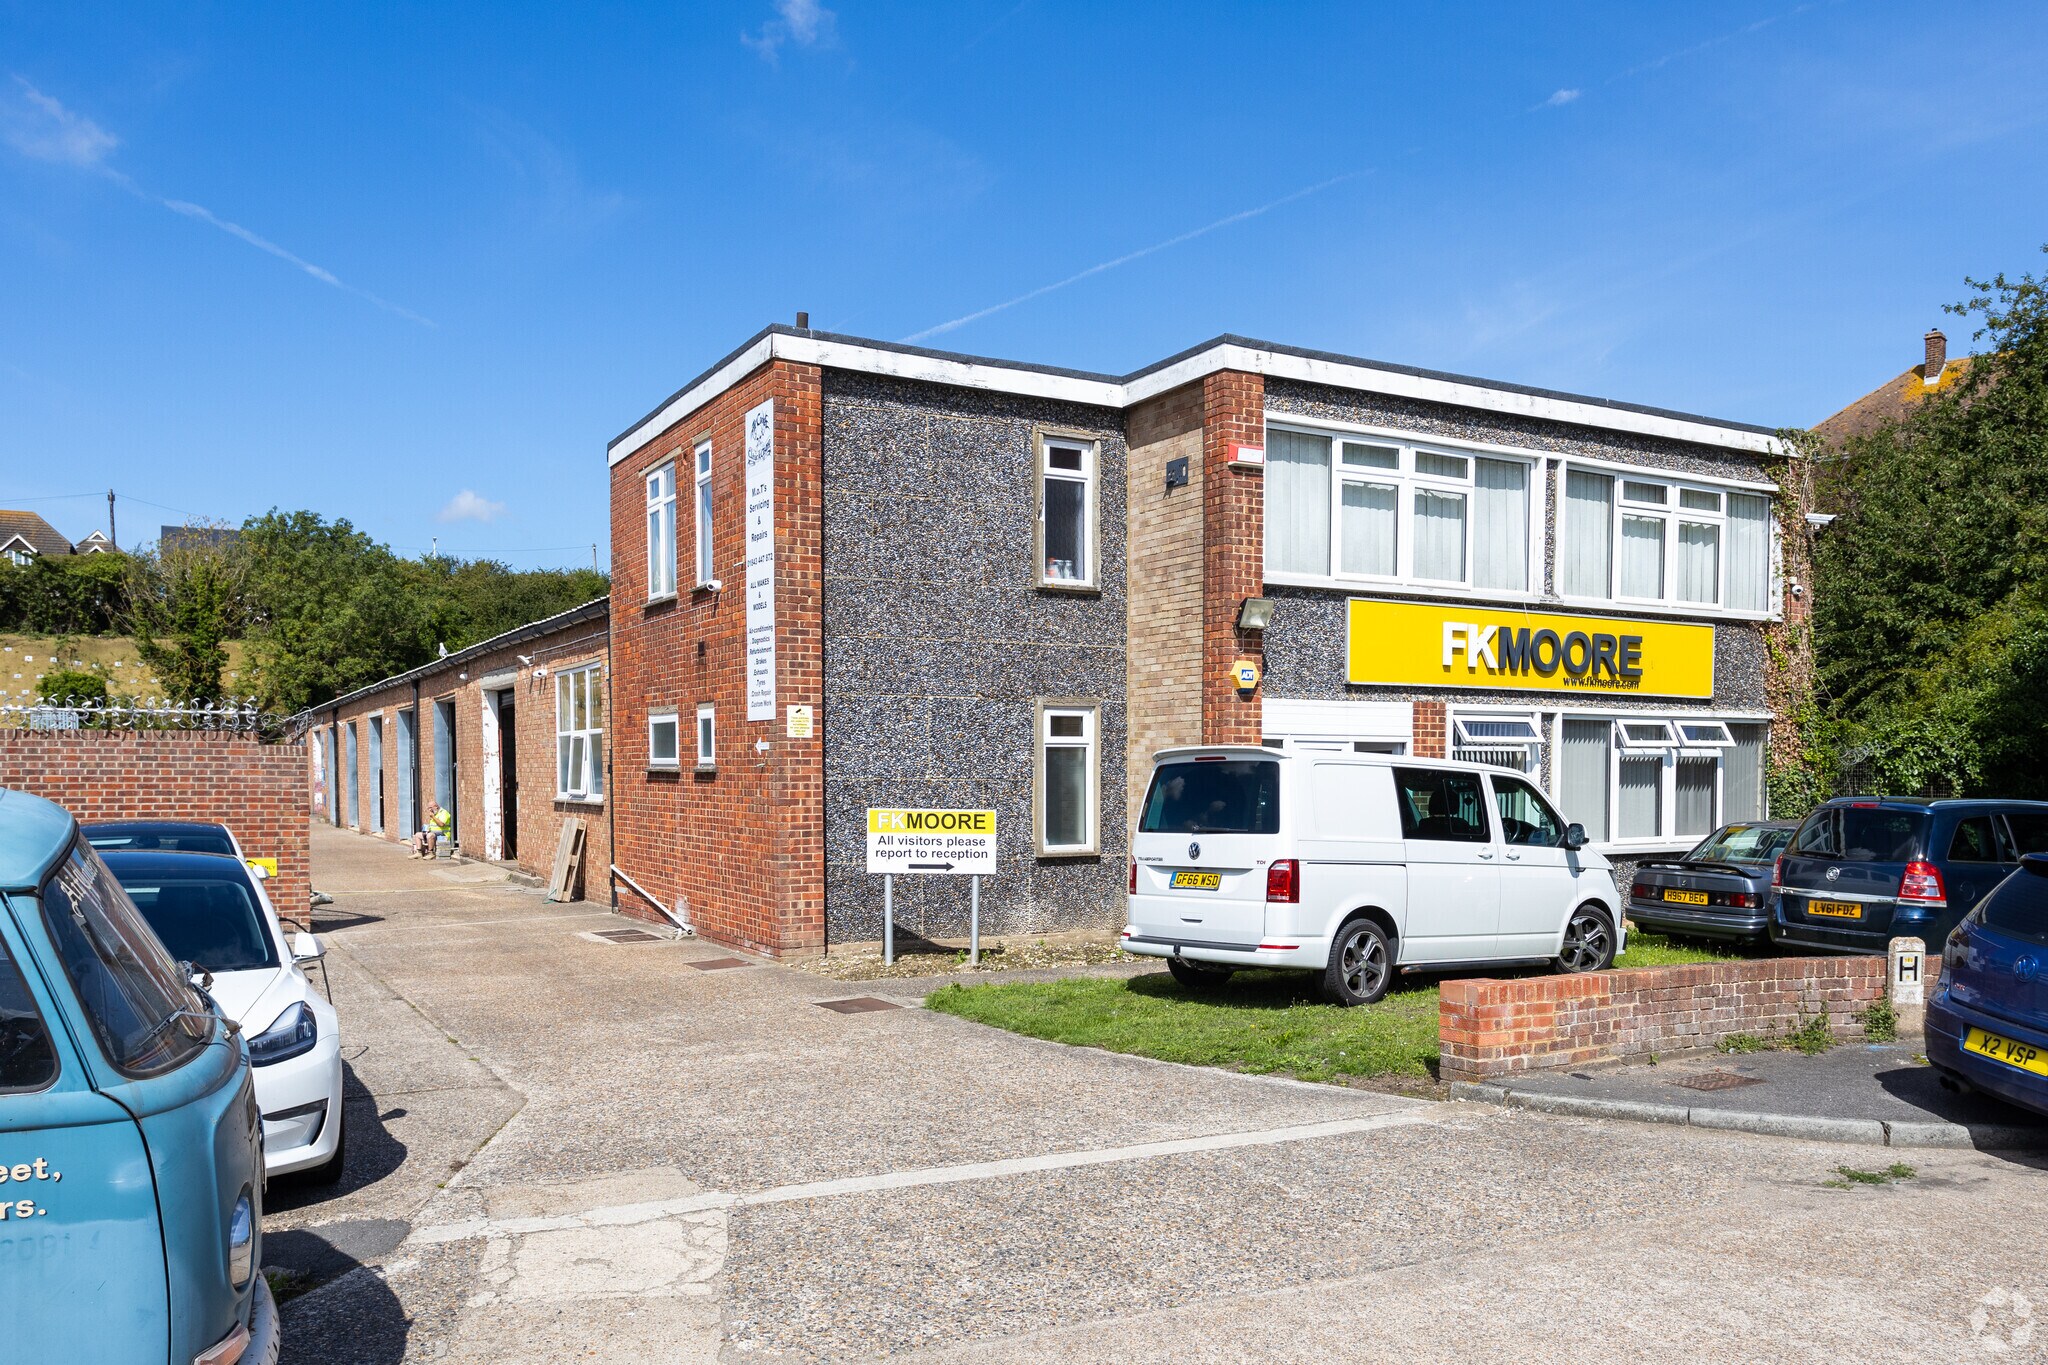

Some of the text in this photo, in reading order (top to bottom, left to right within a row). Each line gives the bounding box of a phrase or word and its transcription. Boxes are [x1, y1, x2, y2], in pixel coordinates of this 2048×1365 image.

[749, 499, 770, 513] Servicing
[751, 530, 767, 543] Repairs
[1442, 621, 1643, 676] FKMOORE
[1241, 670, 1254, 680] ADT
[1563, 676, 1640, 690] www.fkmoore.com
[877, 812, 986, 830] FKMOORE
[877, 835, 986, 848] All visitors please
[875, 848, 988, 860] report to reception
[1176, 873, 1219, 886] GF66 WSD
[1667, 890, 1705, 903] H967 BEG
[1814, 902, 1855, 916] LV61 FDZ
[1899, 955, 1918, 982] H
[1980, 1034, 2037, 1066] X2 VSP
